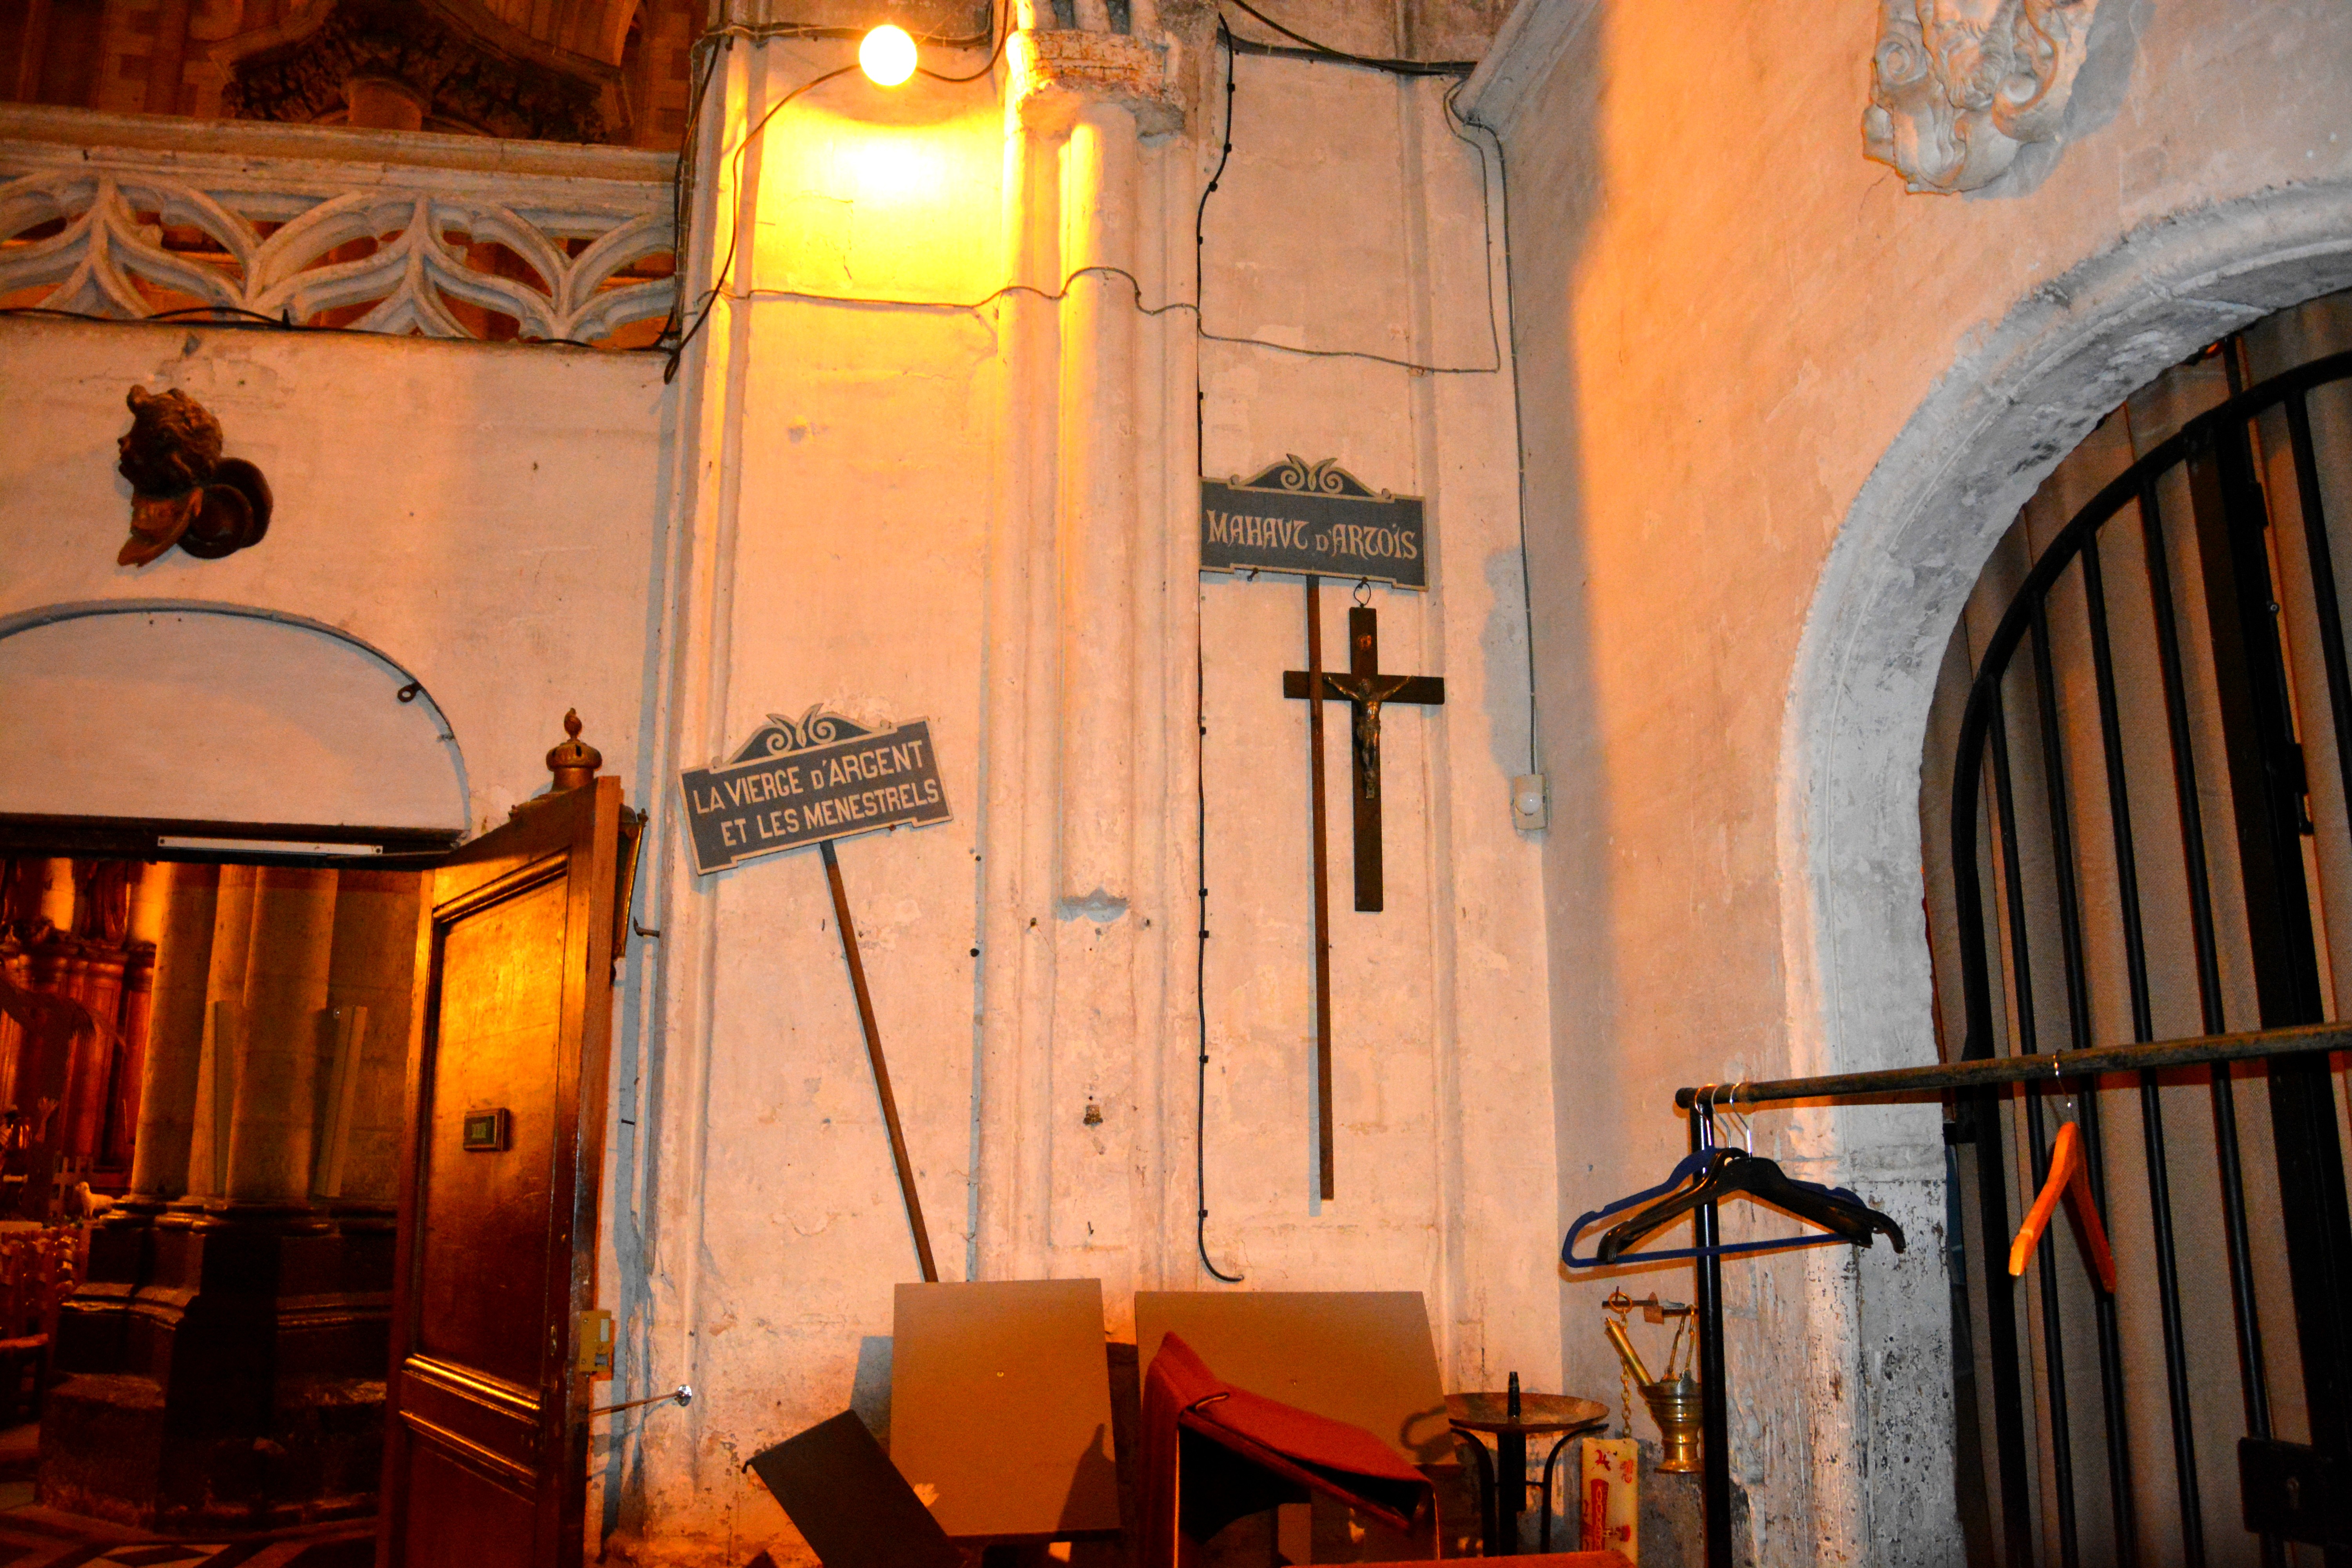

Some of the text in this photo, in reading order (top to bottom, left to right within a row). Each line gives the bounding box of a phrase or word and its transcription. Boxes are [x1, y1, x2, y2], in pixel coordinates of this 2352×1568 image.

[693, 740, 923, 814] LA VIERGE D'ARGENT
[720, 779, 939, 847] ET LES MENESTRELS
